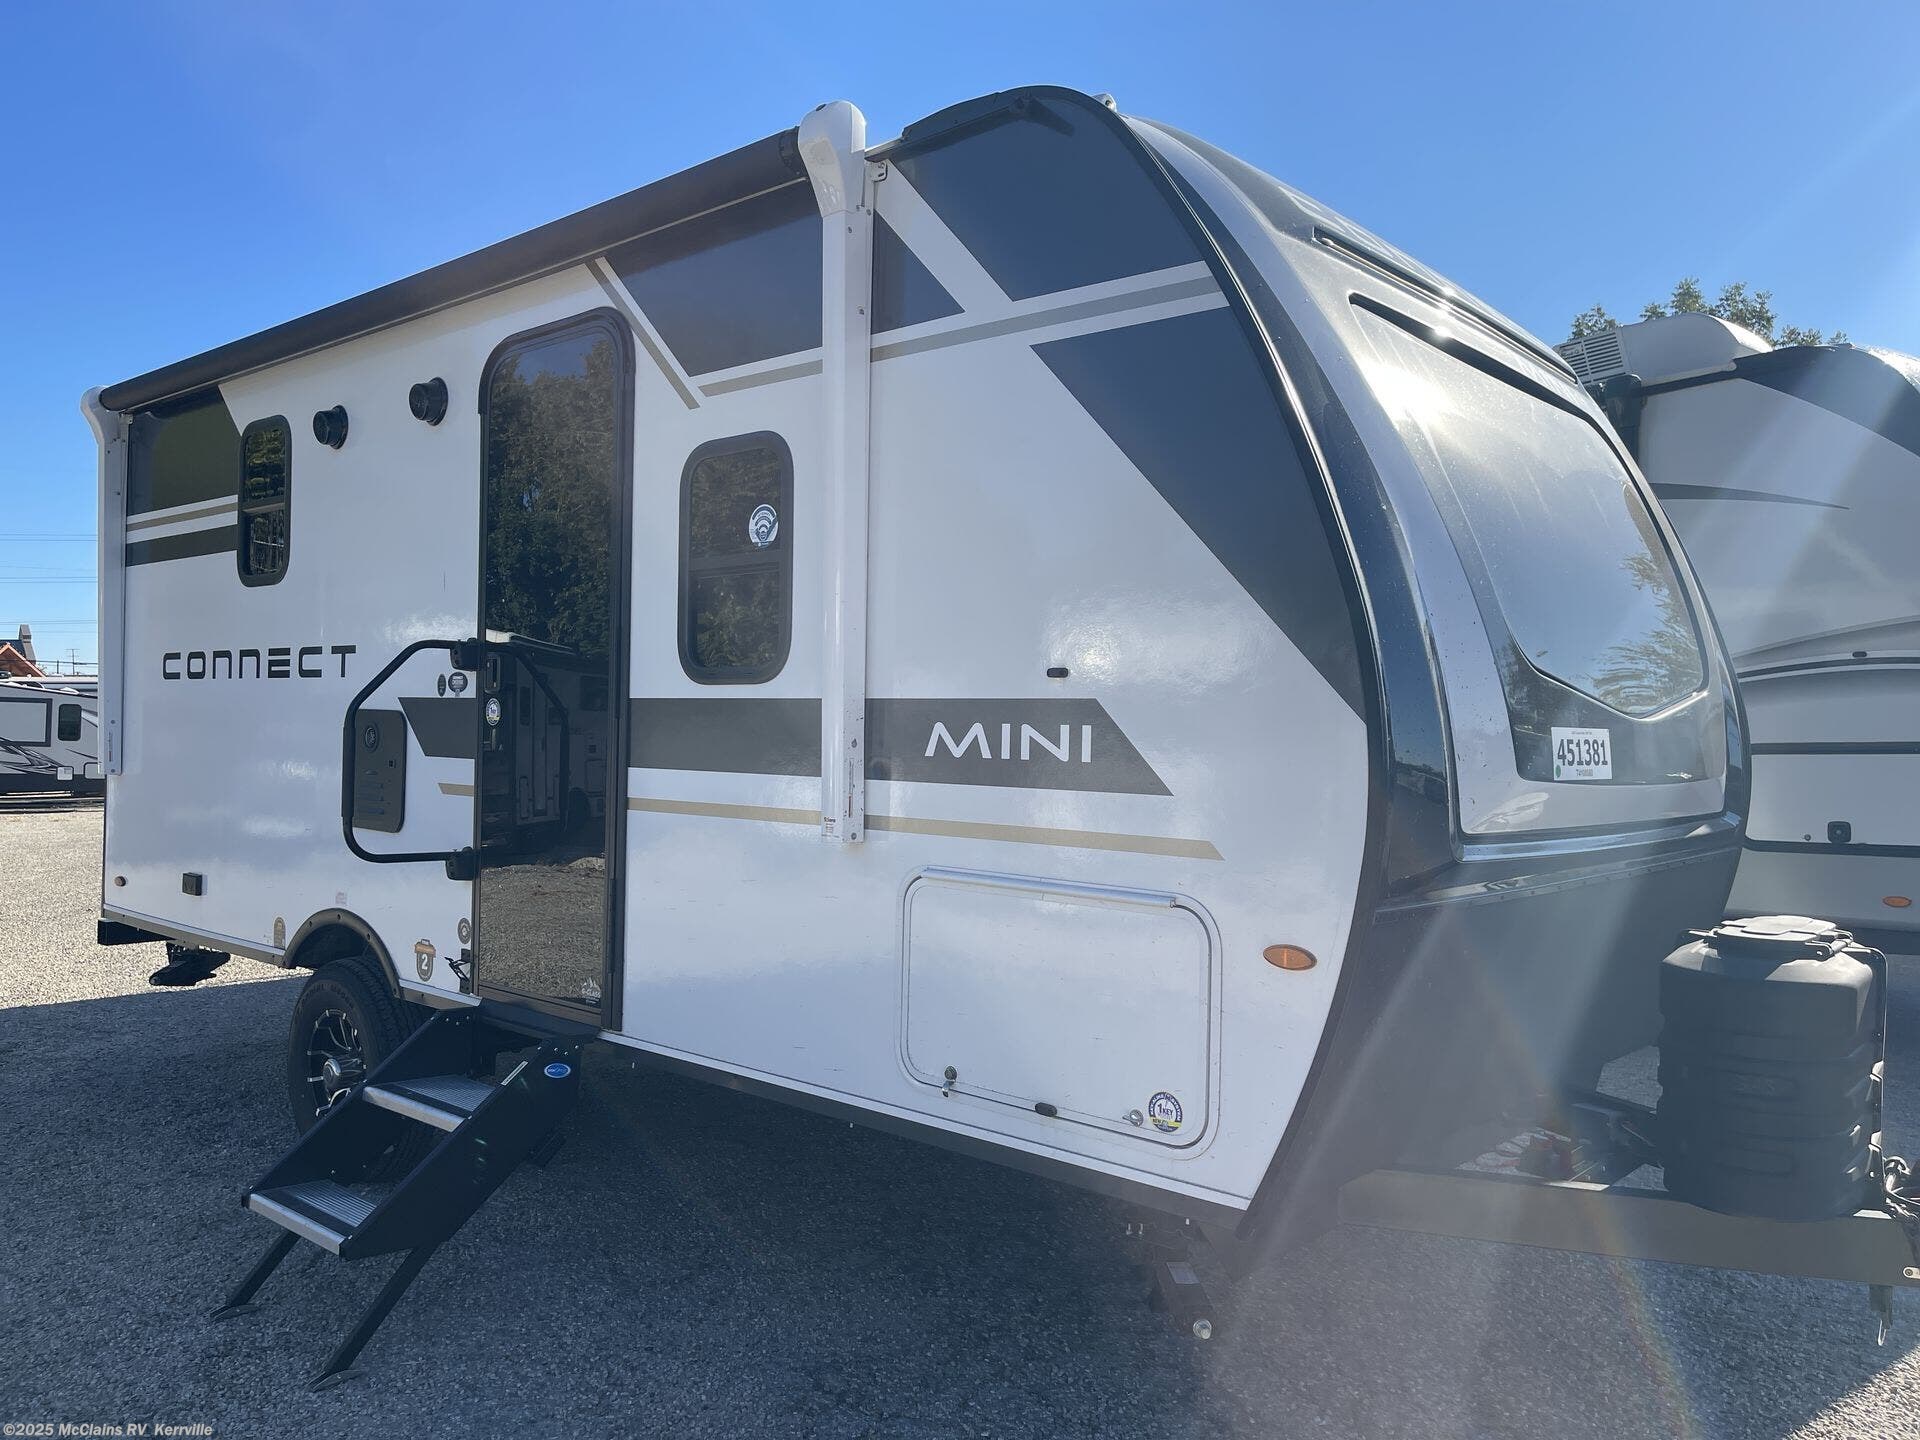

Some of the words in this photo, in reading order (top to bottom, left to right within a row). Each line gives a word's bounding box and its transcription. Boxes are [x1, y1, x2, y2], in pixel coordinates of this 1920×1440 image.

[163, 645, 357, 680] CONNECT
[924, 721, 1092, 763] MINI
[1557, 738, 1608, 766] 451381
[421, 953, 428, 970] 2
